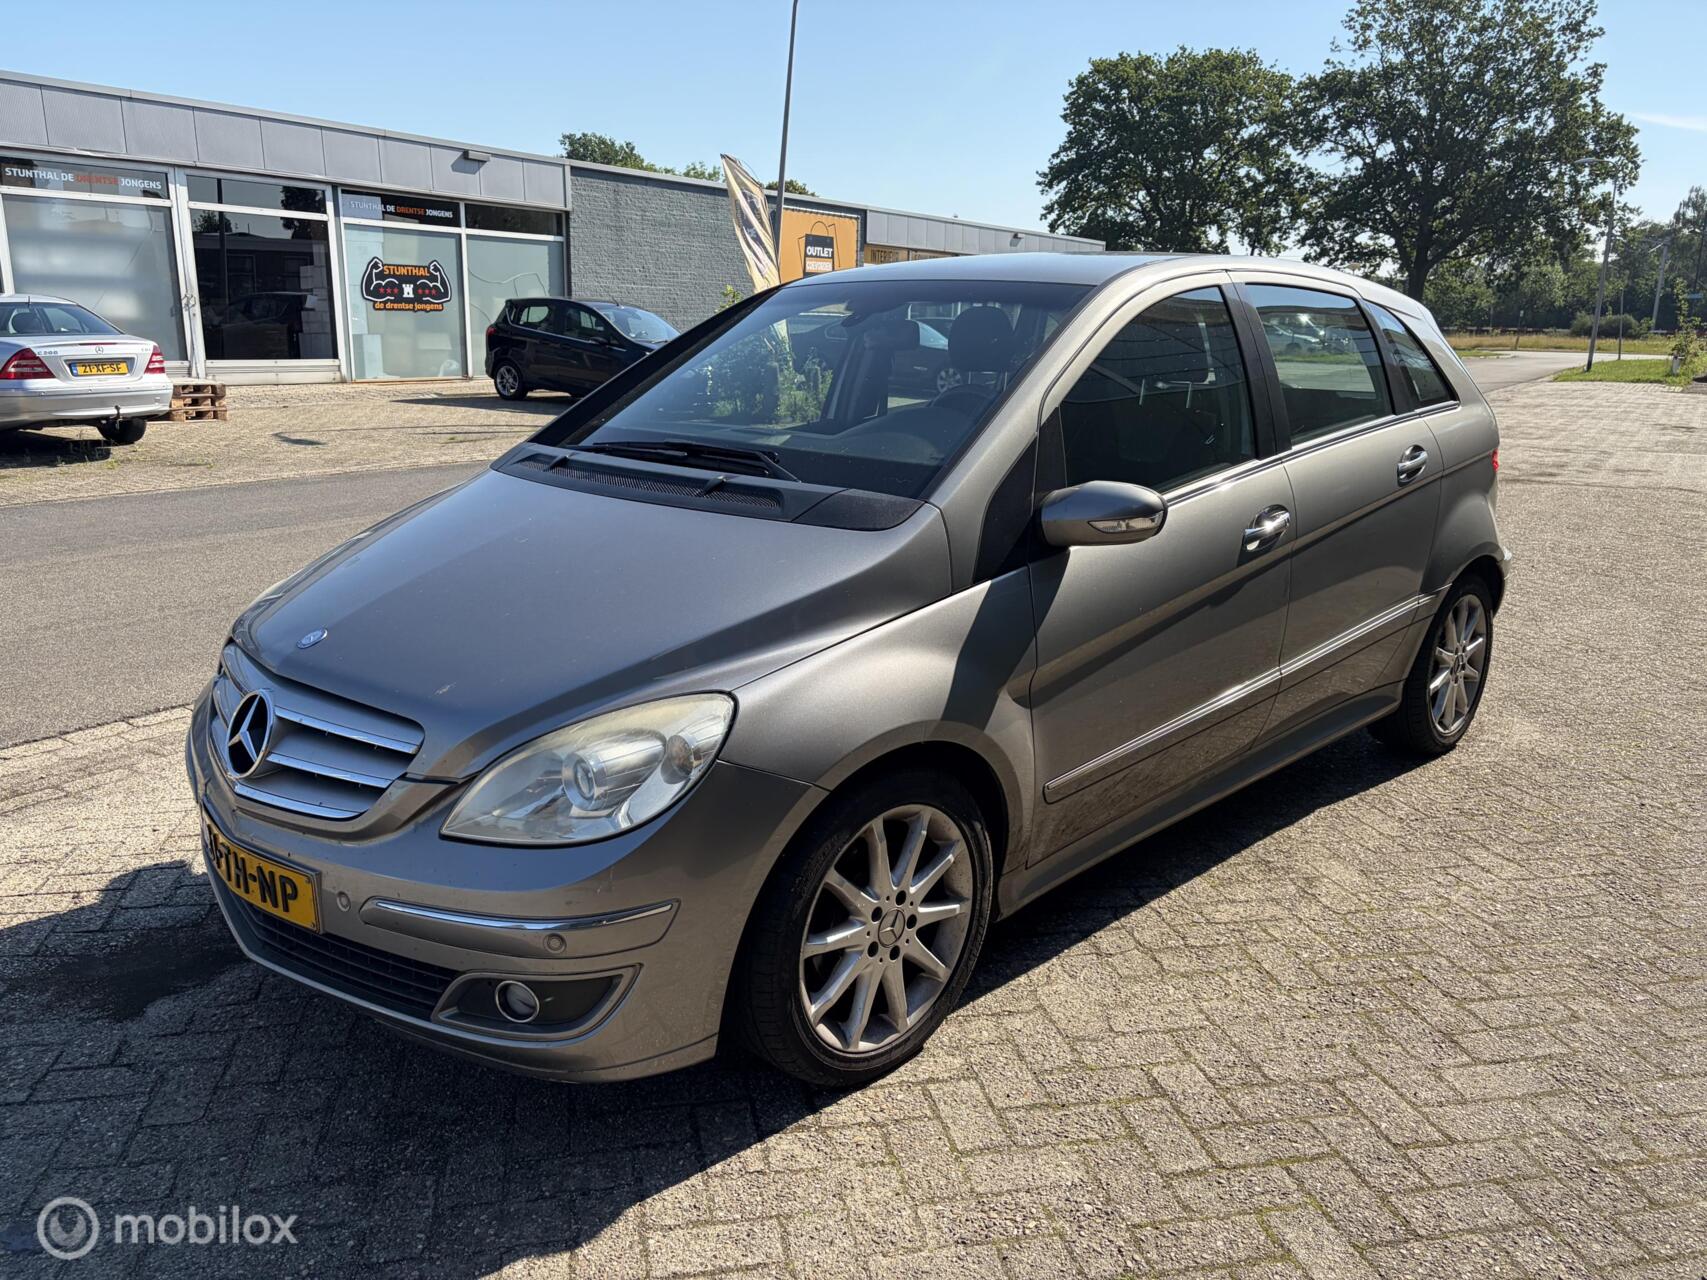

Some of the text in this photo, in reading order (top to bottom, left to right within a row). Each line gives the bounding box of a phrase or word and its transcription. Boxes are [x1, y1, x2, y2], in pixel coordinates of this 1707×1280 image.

[5, 167, 58, 181] STUNTHAL
[61, 173, 74, 182] DE
[121, 178, 162, 190] JONGENS
[350, 201, 453, 219] STUNTHAL DE DRENTSE JONGENS
[806, 246, 833, 257] OUTLET
[383, 265, 431, 277] STUNTHAL
[385, 302, 413, 310] drentse
[414, 302, 442, 311] jongens
[82, 362, 122, 374] 21-XF-SF
